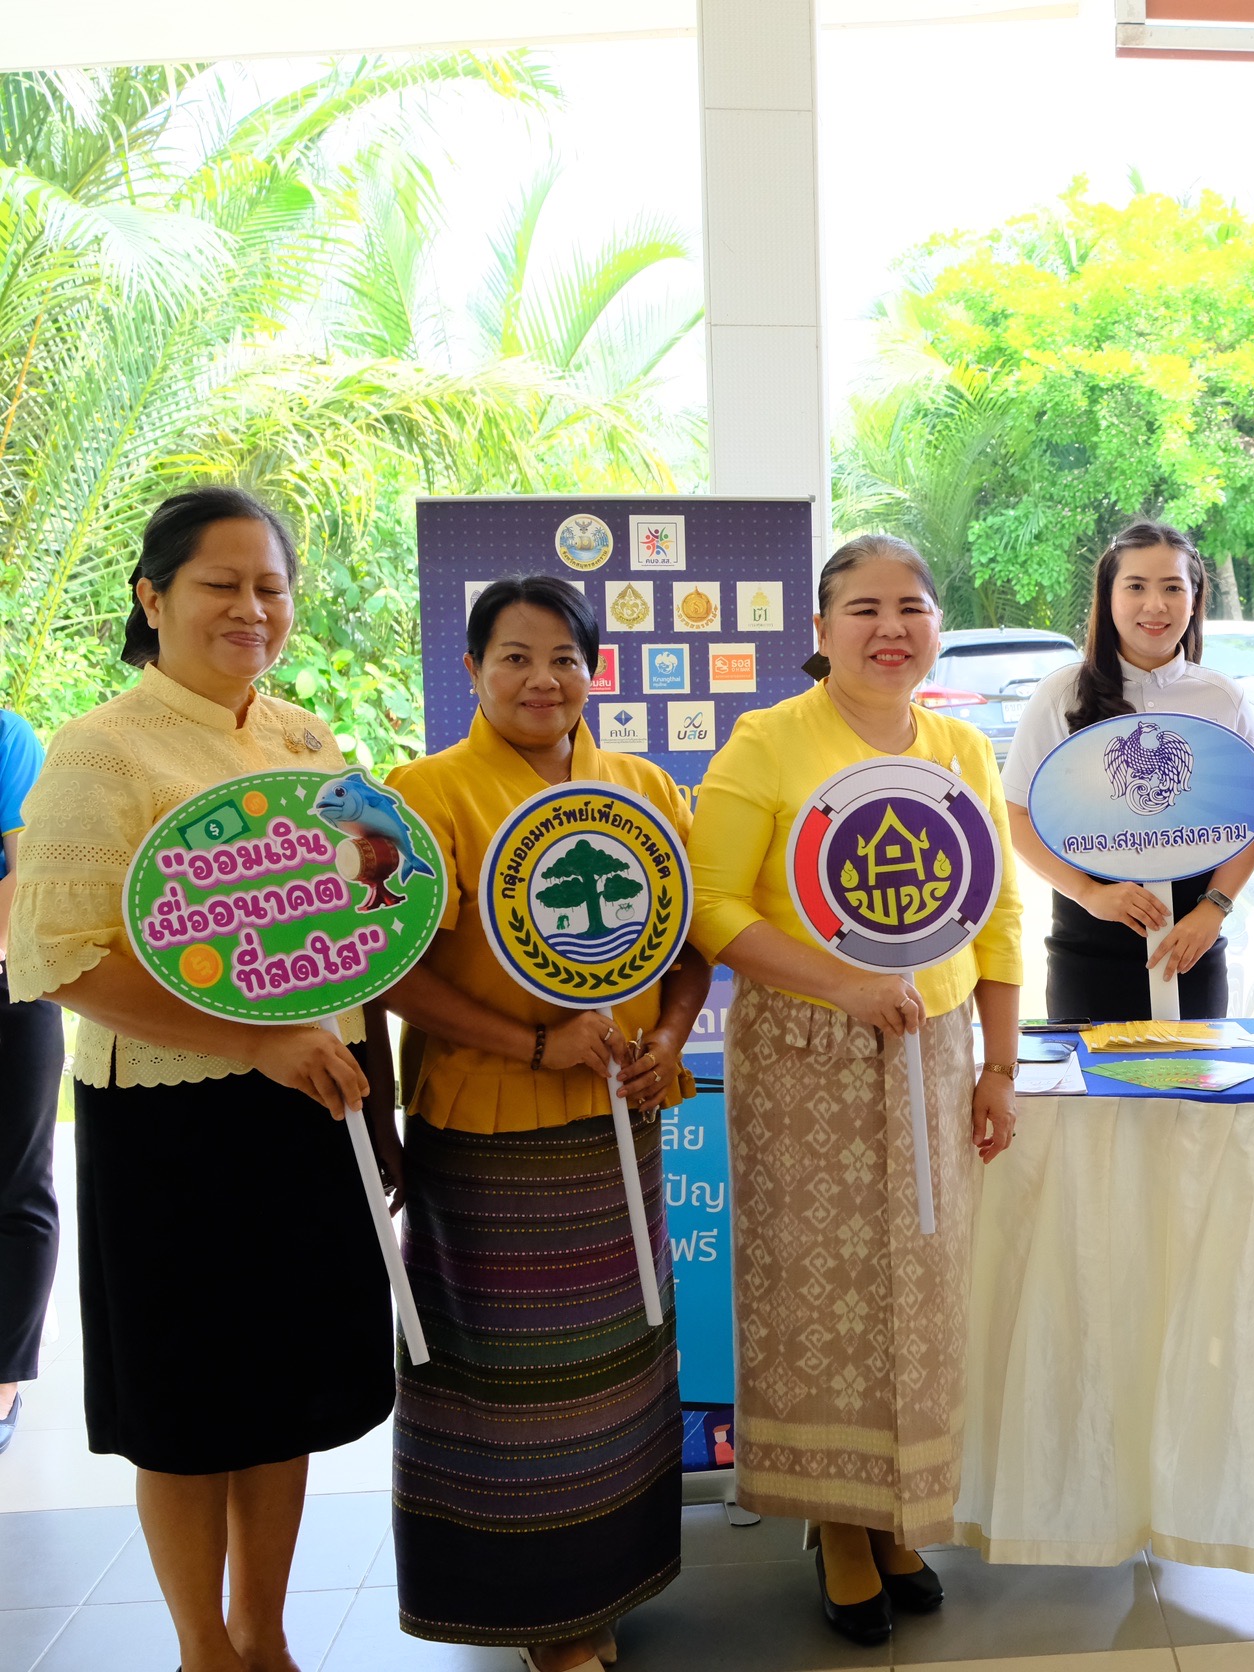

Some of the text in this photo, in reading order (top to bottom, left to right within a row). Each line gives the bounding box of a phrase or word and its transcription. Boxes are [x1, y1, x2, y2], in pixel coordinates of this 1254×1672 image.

[653, 676, 681, 684] Krungthai
[609, 727, 639, 738] คปภ.
[677, 729, 707, 740] บสย
[161, 821, 329, 880] "ออมเงิน
[500, 801, 671, 900] กลุ่มออมทรัพย์เพื่อการผลิต
[1065, 823, 1248, 854] คบจ.สมุทรสงคราม
[148, 876, 344, 942] เพื่ออนาคต
[236, 929, 380, 994] ที่สดใส"
